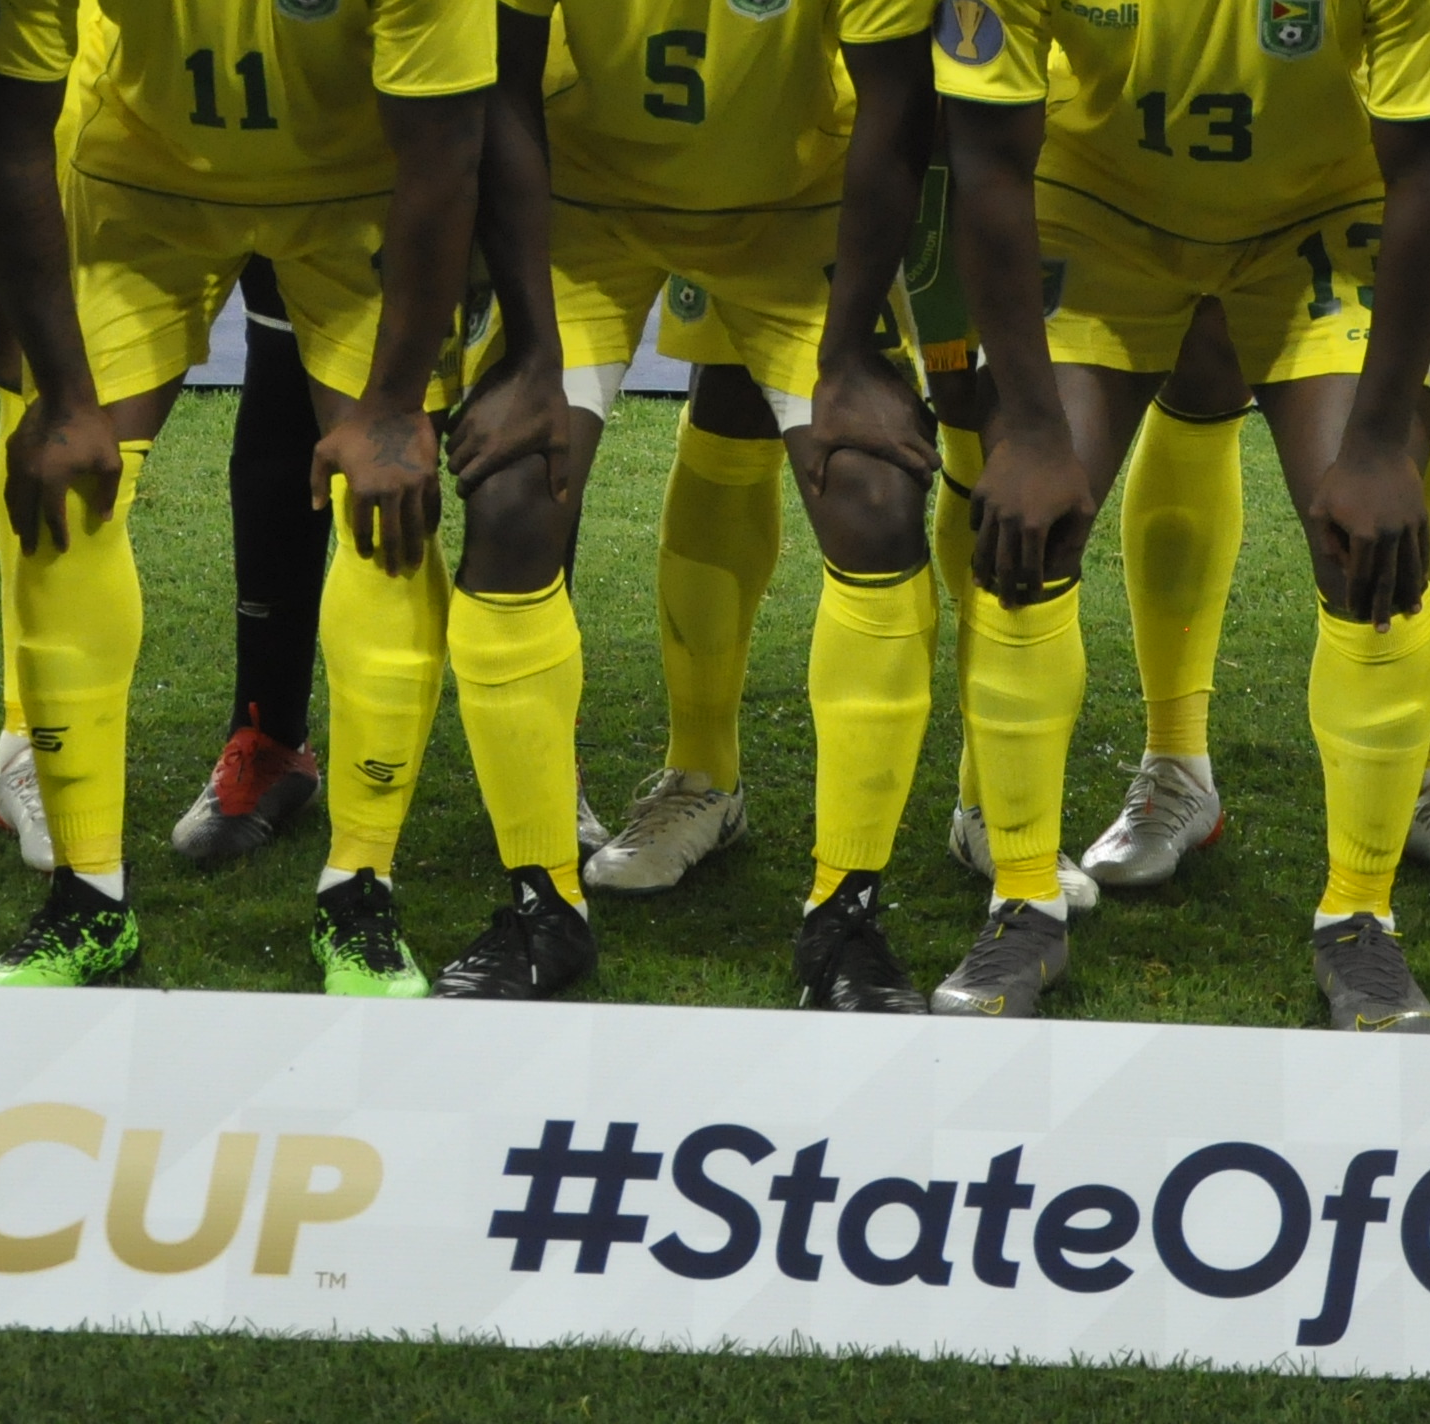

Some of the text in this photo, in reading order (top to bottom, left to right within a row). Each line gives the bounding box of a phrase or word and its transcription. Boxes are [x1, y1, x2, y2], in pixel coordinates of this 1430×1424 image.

[184, 48, 279, 131] 11
[643, 29, 707, 125] 5
[1136, 91, 1253, 162] 13
